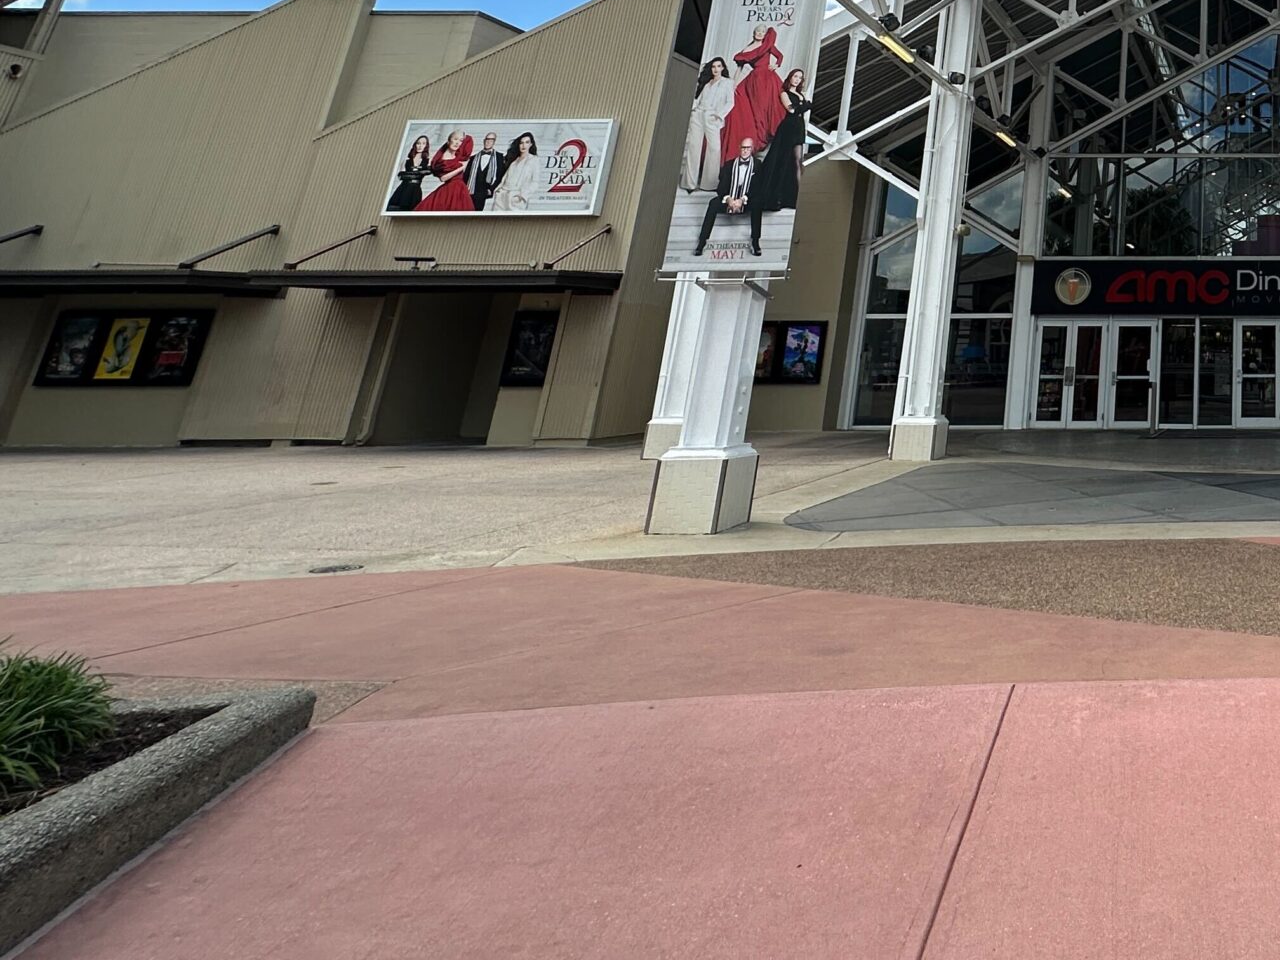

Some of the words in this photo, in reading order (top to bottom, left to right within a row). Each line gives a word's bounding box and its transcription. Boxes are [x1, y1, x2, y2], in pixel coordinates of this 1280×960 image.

[545, 156, 596, 168] DEVIL
[716, 242, 751, 250] THEATERS
[711, 250, 737, 260] MAY
[740, 250, 745, 259] 1
